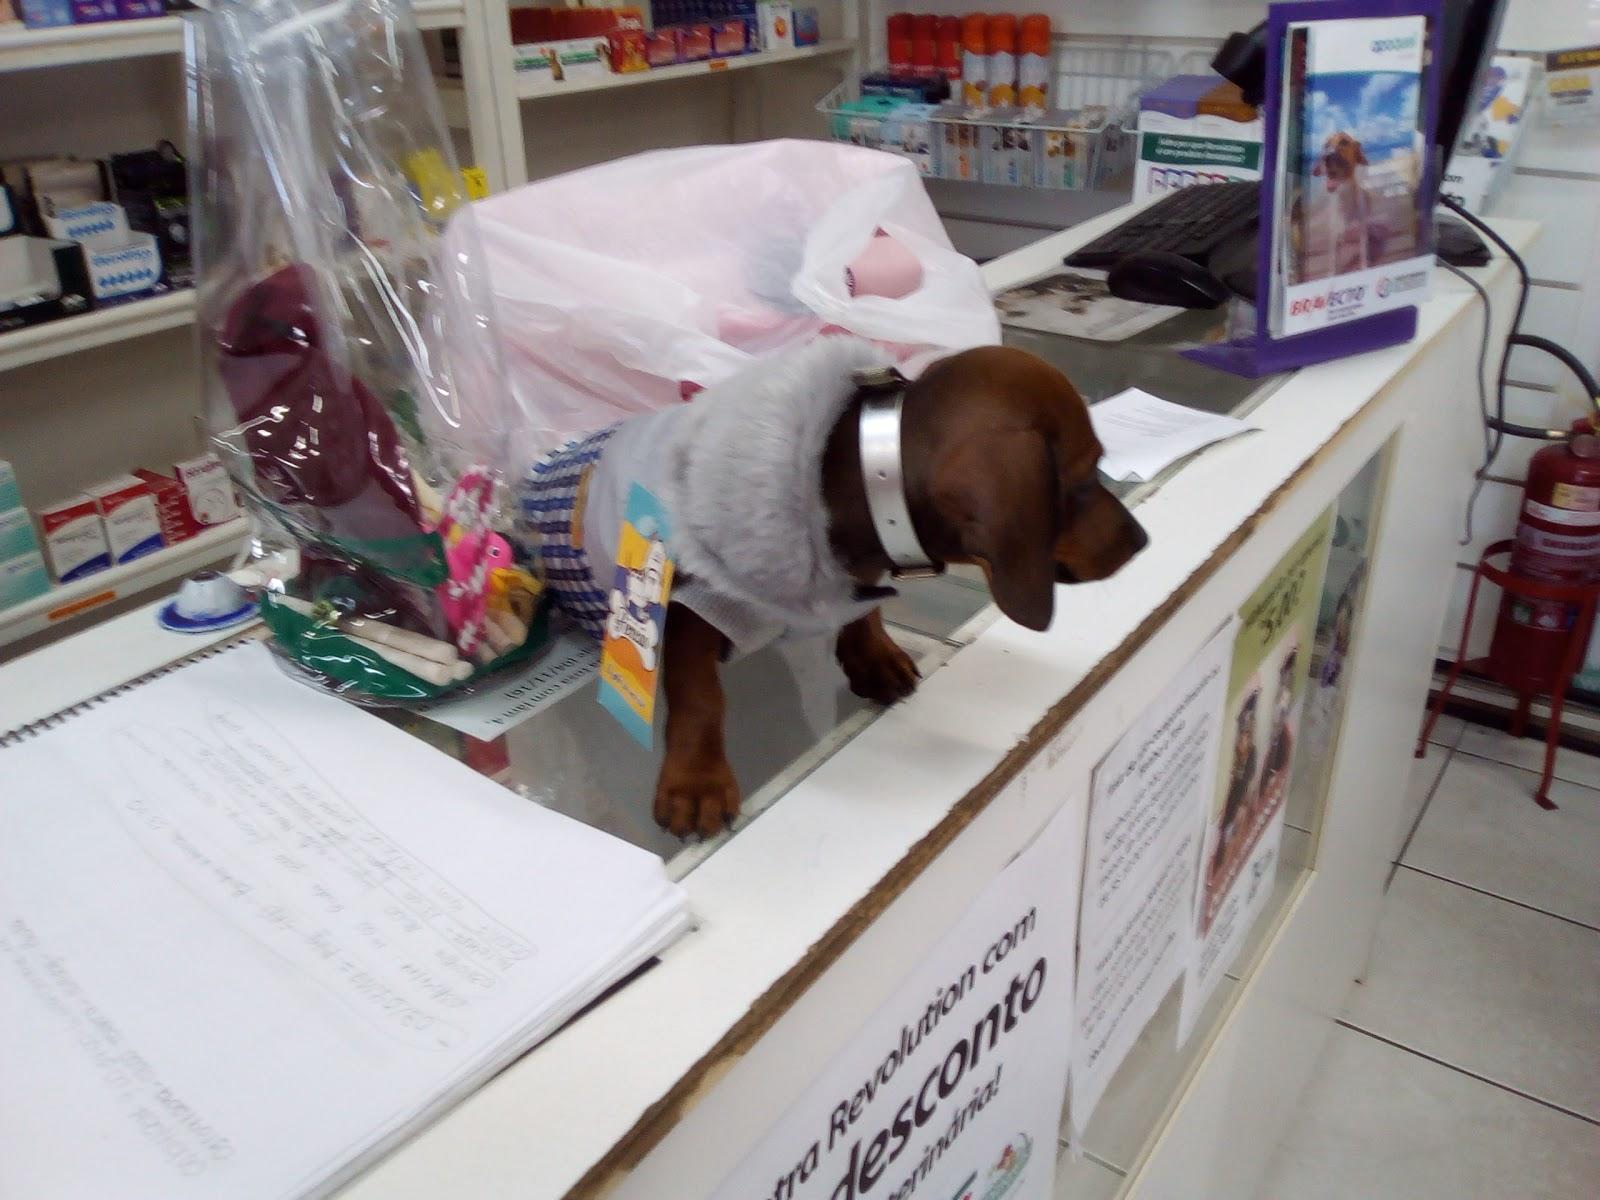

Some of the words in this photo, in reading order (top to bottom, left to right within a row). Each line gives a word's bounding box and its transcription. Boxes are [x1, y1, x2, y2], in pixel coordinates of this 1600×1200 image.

[768, 1141, 819, 1200] tra
[828, 965, 976, 1151] Revolution
[982, 906, 1037, 975] com
[830, 956, 1048, 1200] desconto
